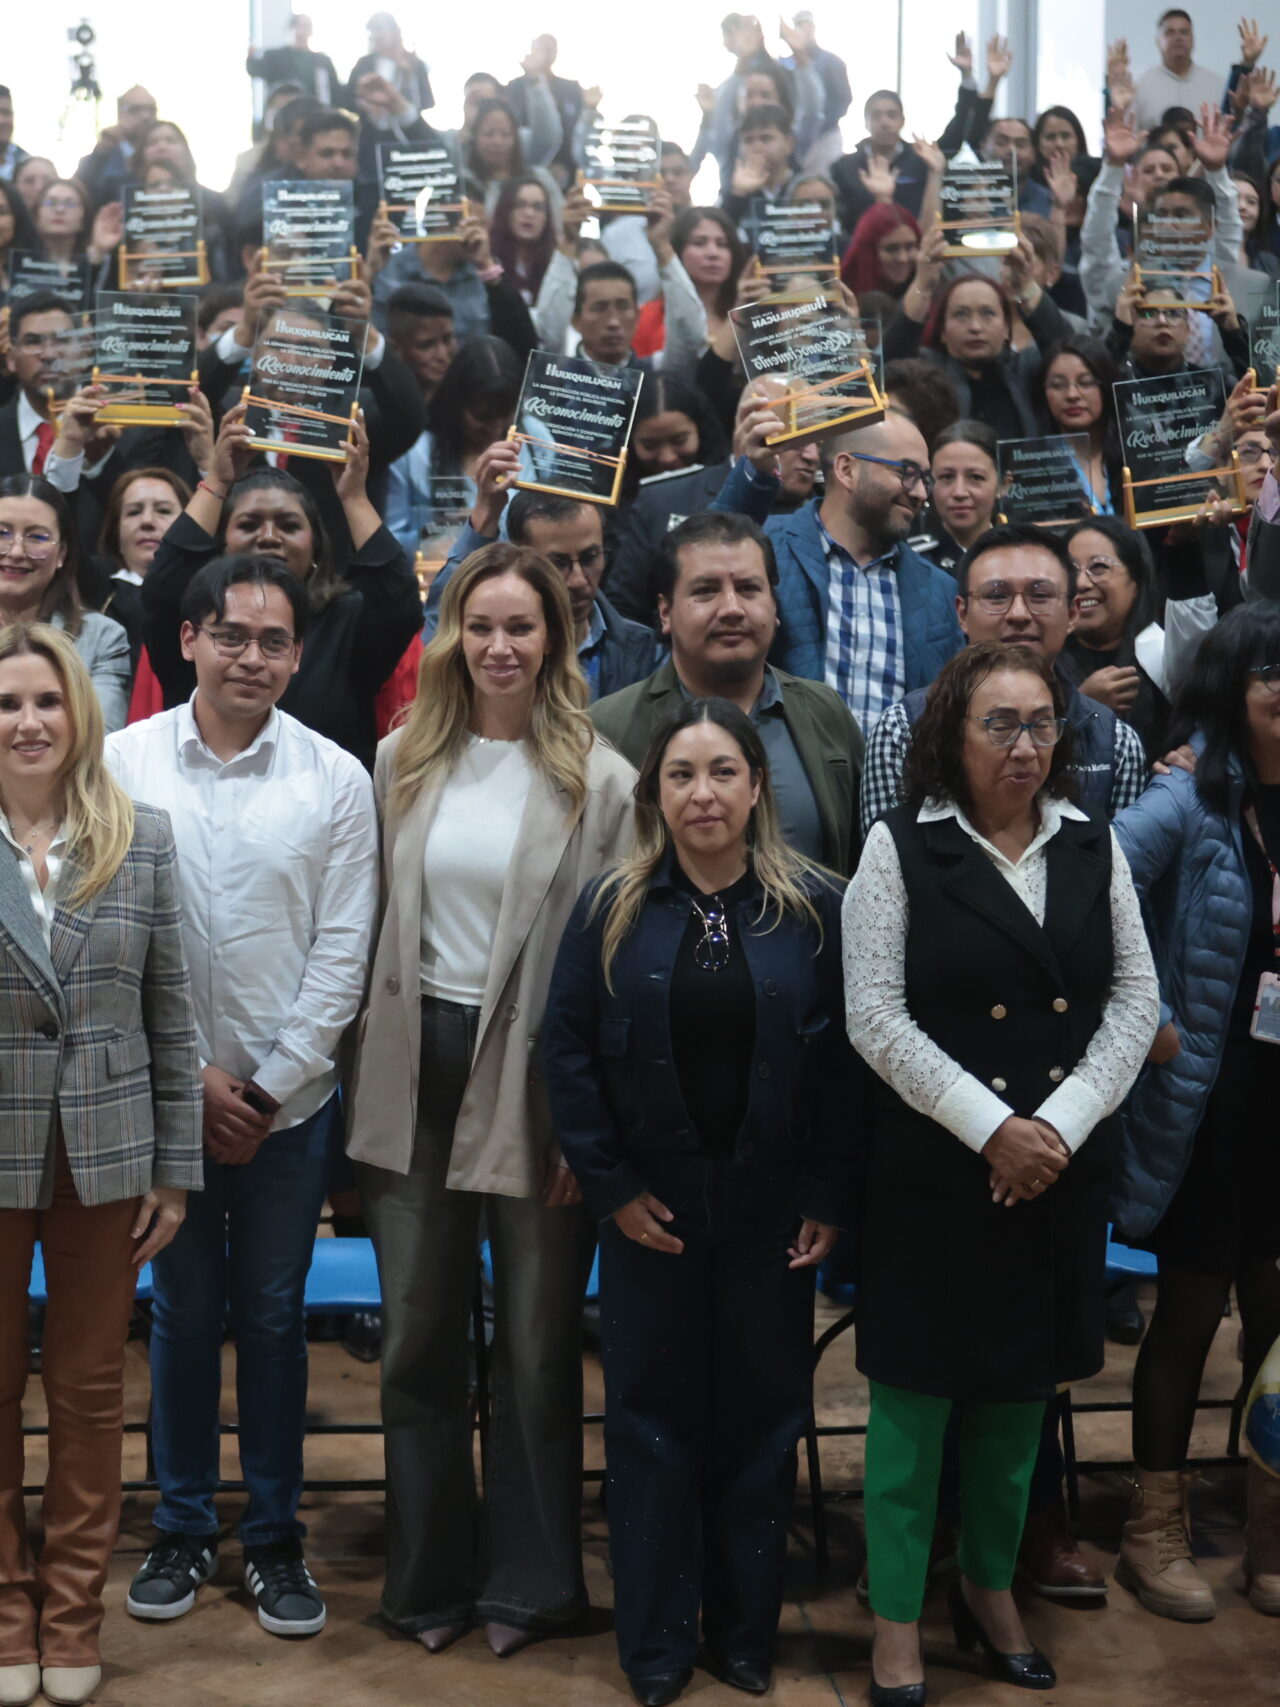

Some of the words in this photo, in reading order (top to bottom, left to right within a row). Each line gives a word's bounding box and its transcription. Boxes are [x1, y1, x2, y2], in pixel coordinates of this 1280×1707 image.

[256, 354, 356, 382] Reconocimiento
[523, 396, 626, 428] Reconocimiento
[1126, 420, 1220, 448] Reconocimient
